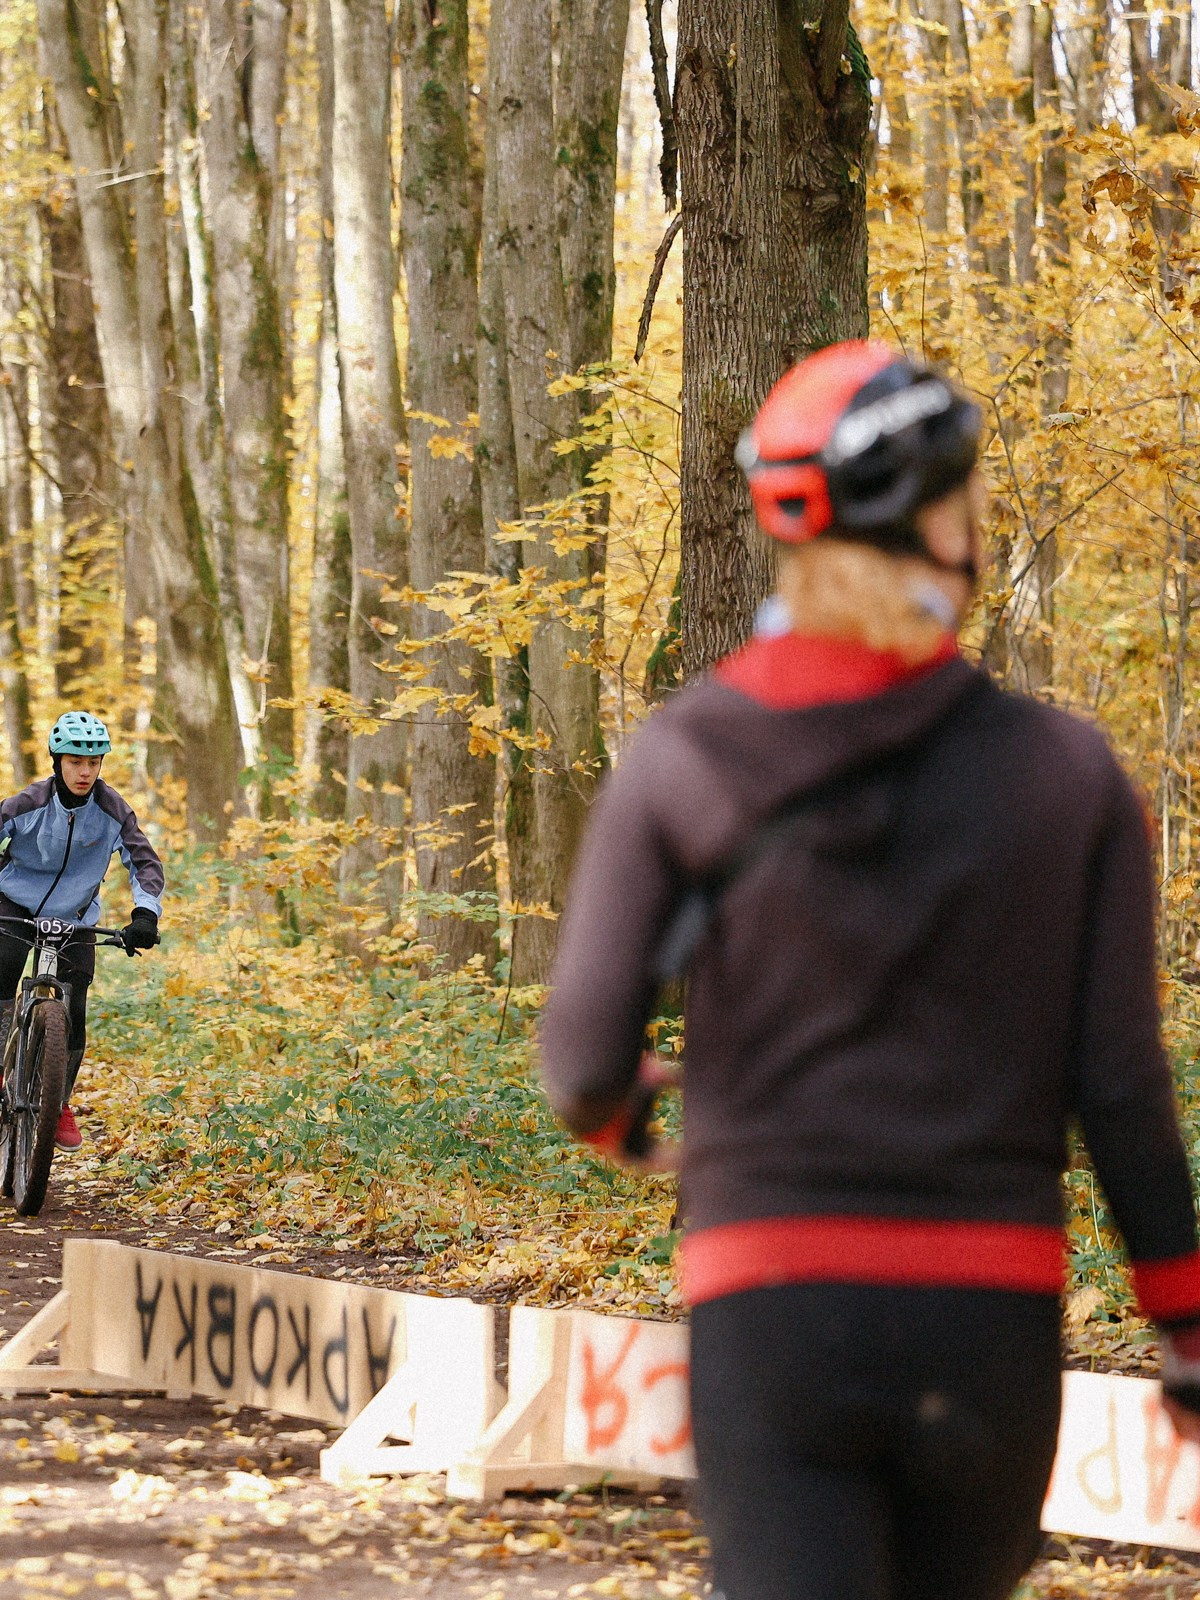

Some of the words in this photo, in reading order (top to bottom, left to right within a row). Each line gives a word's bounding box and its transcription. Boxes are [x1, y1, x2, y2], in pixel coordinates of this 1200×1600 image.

[40, 920, 73, 934] 052
[136, 1257, 397, 1415] АРКОВКА
[1076, 1393, 1200, 1530] АР
